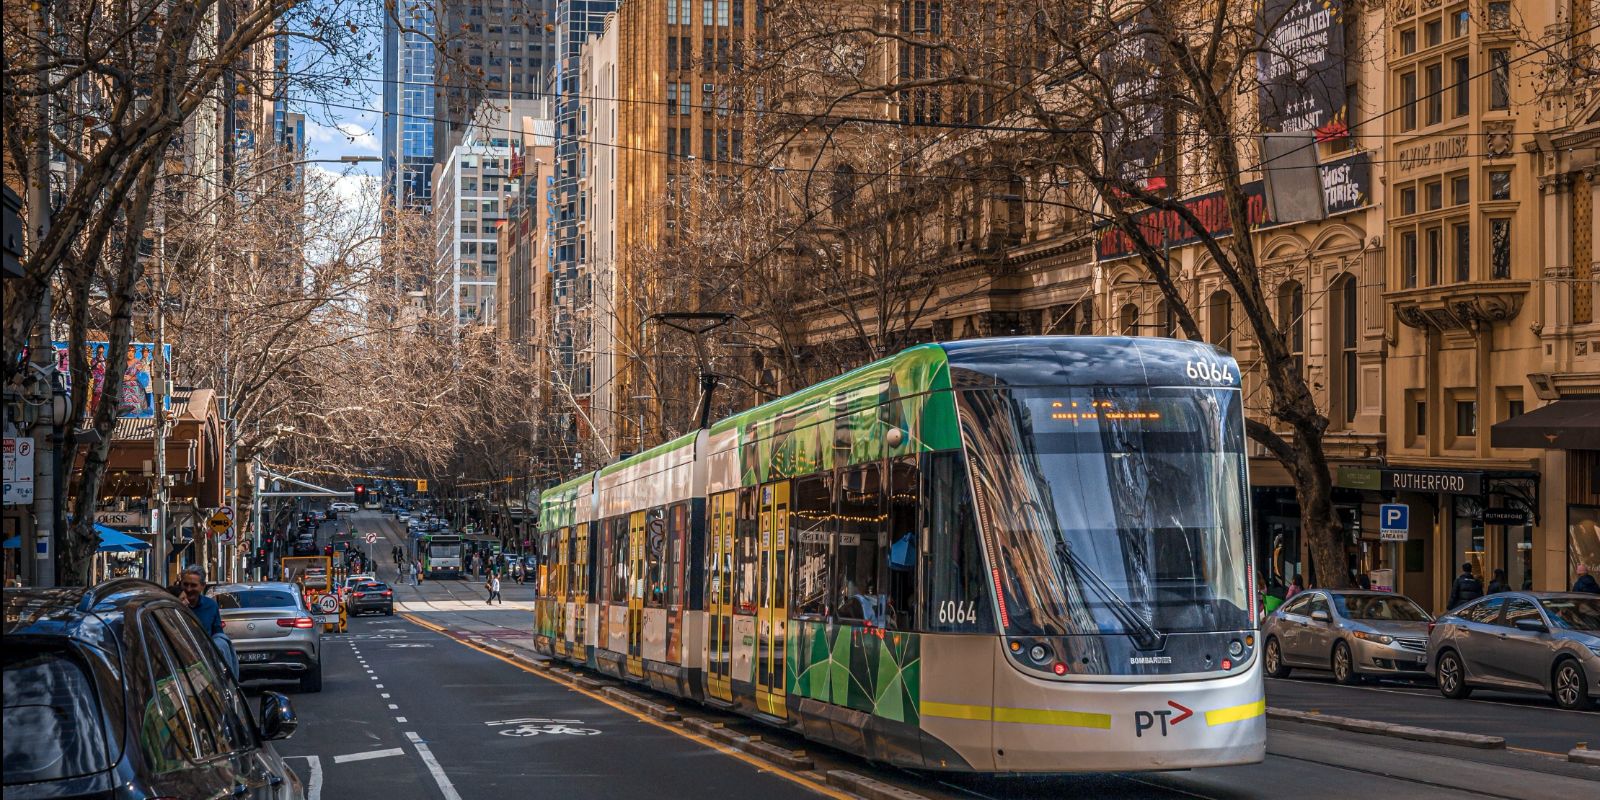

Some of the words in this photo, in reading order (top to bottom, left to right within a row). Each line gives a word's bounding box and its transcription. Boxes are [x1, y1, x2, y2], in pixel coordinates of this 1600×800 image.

[1400, 143, 1431, 172] CLYDE
[1434, 136, 1469, 164] HOUSE
[1322, 163, 1350, 188] HOST
[1325, 180, 1359, 208] TORIES
[1186, 360, 1233, 383] 6064
[1393, 473, 1464, 491] RUTHERFORD
[1387, 509, 1401, 526] P
[323, 599, 335, 608] 40
[939, 600, 977, 623] 6064
